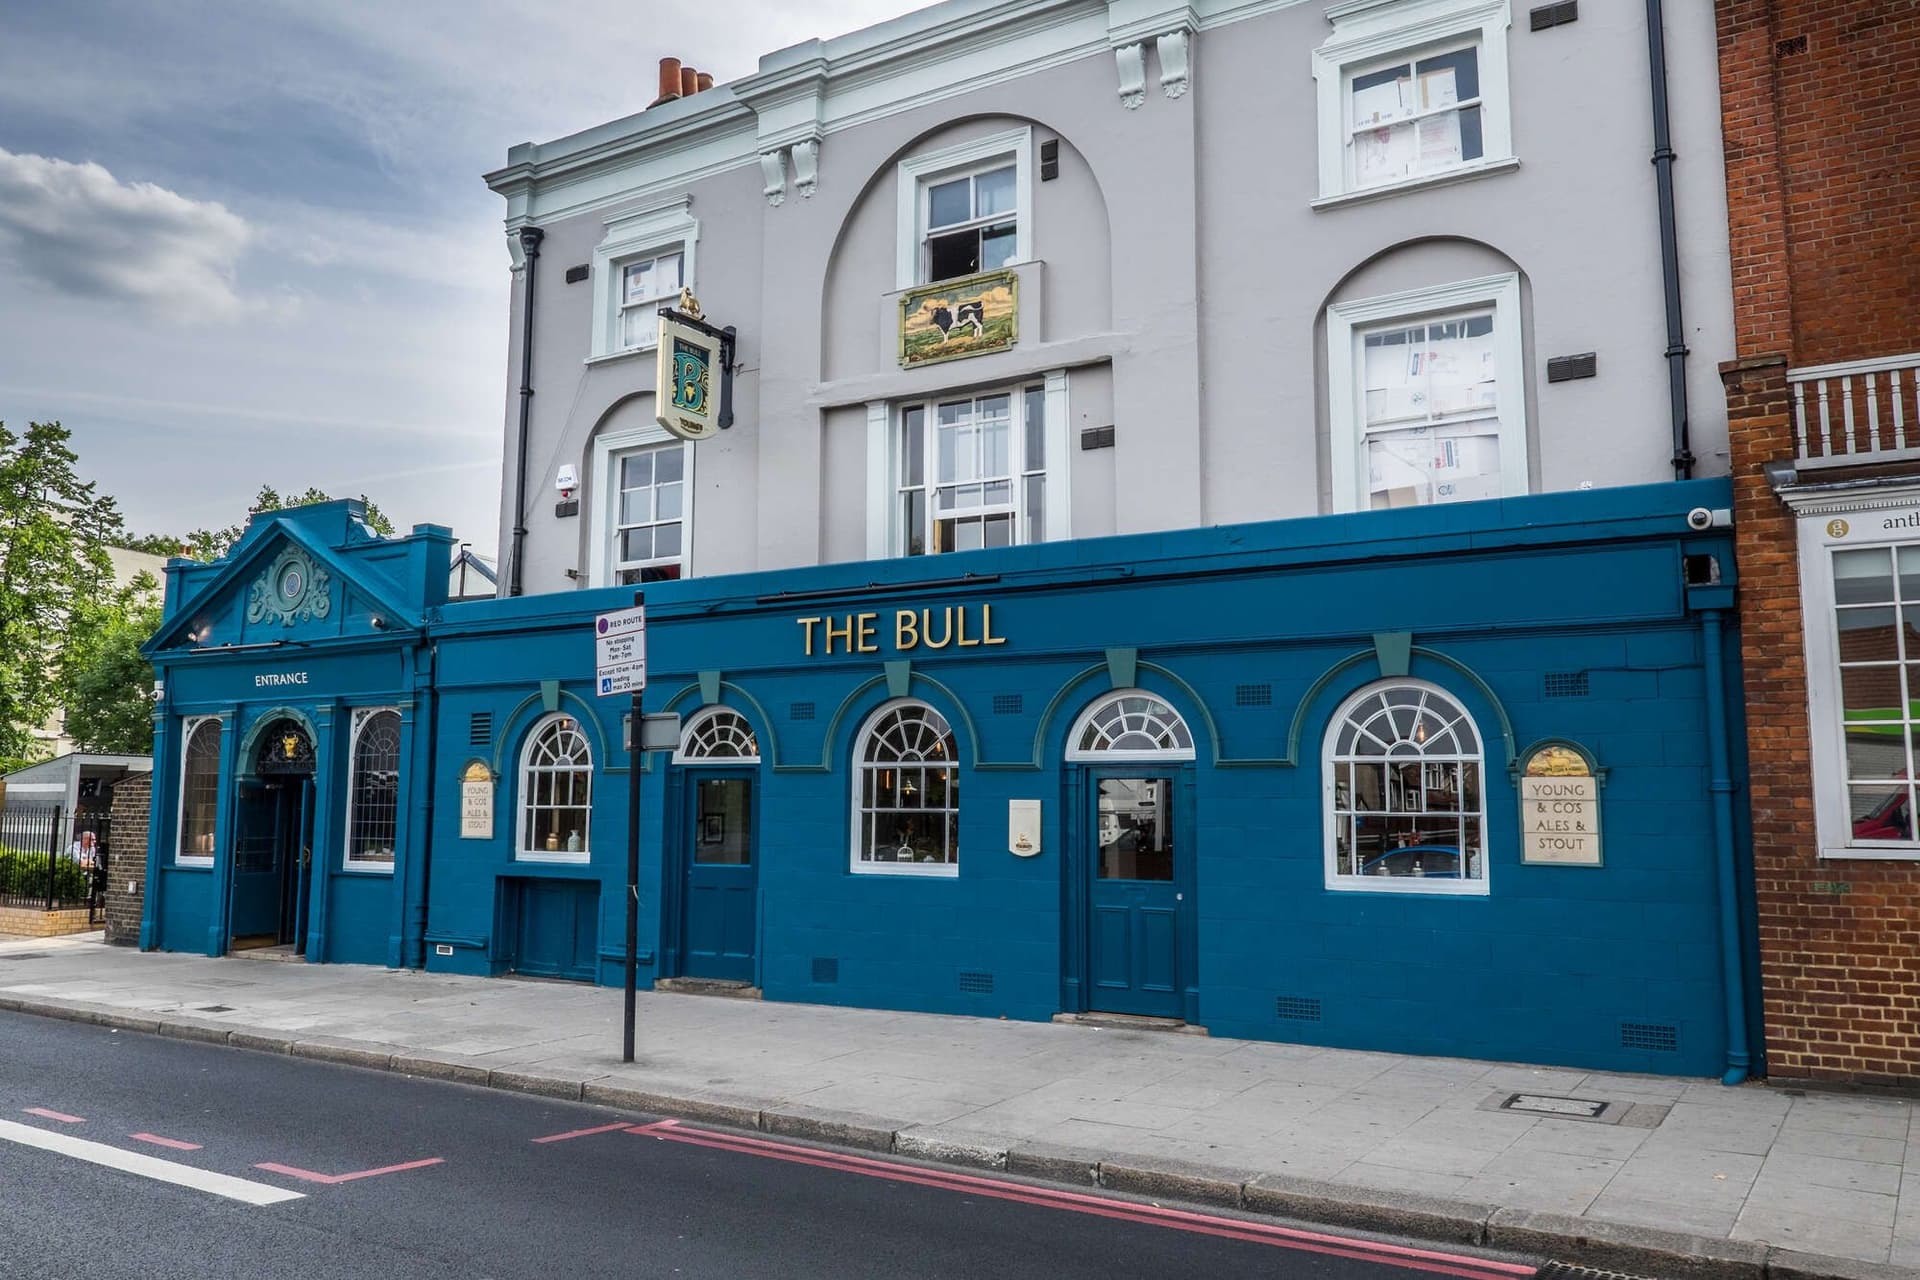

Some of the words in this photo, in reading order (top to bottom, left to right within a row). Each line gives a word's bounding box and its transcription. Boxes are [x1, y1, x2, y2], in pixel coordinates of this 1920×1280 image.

[610, 620, 621, 628] RED
[623, 616, 641, 625] ROUTE
[797, 612, 879, 656] THE
[896, 603, 1008, 650] BULL
[614, 636, 634, 644] stopping
[599, 668, 615, 677] Except
[255, 671, 308, 687] ENTRANCE
[467, 786, 489, 795] YOUNG
[1532, 784, 1585, 796] YOUNG
[466, 809, 482, 817] ALES
[1537, 802, 1547, 813] &
[467, 820, 487, 829] STOUT
[1536, 819, 1570, 832] ALES
[1575, 820, 1587, 832] &
[1538, 838, 1585, 850] STOUT
